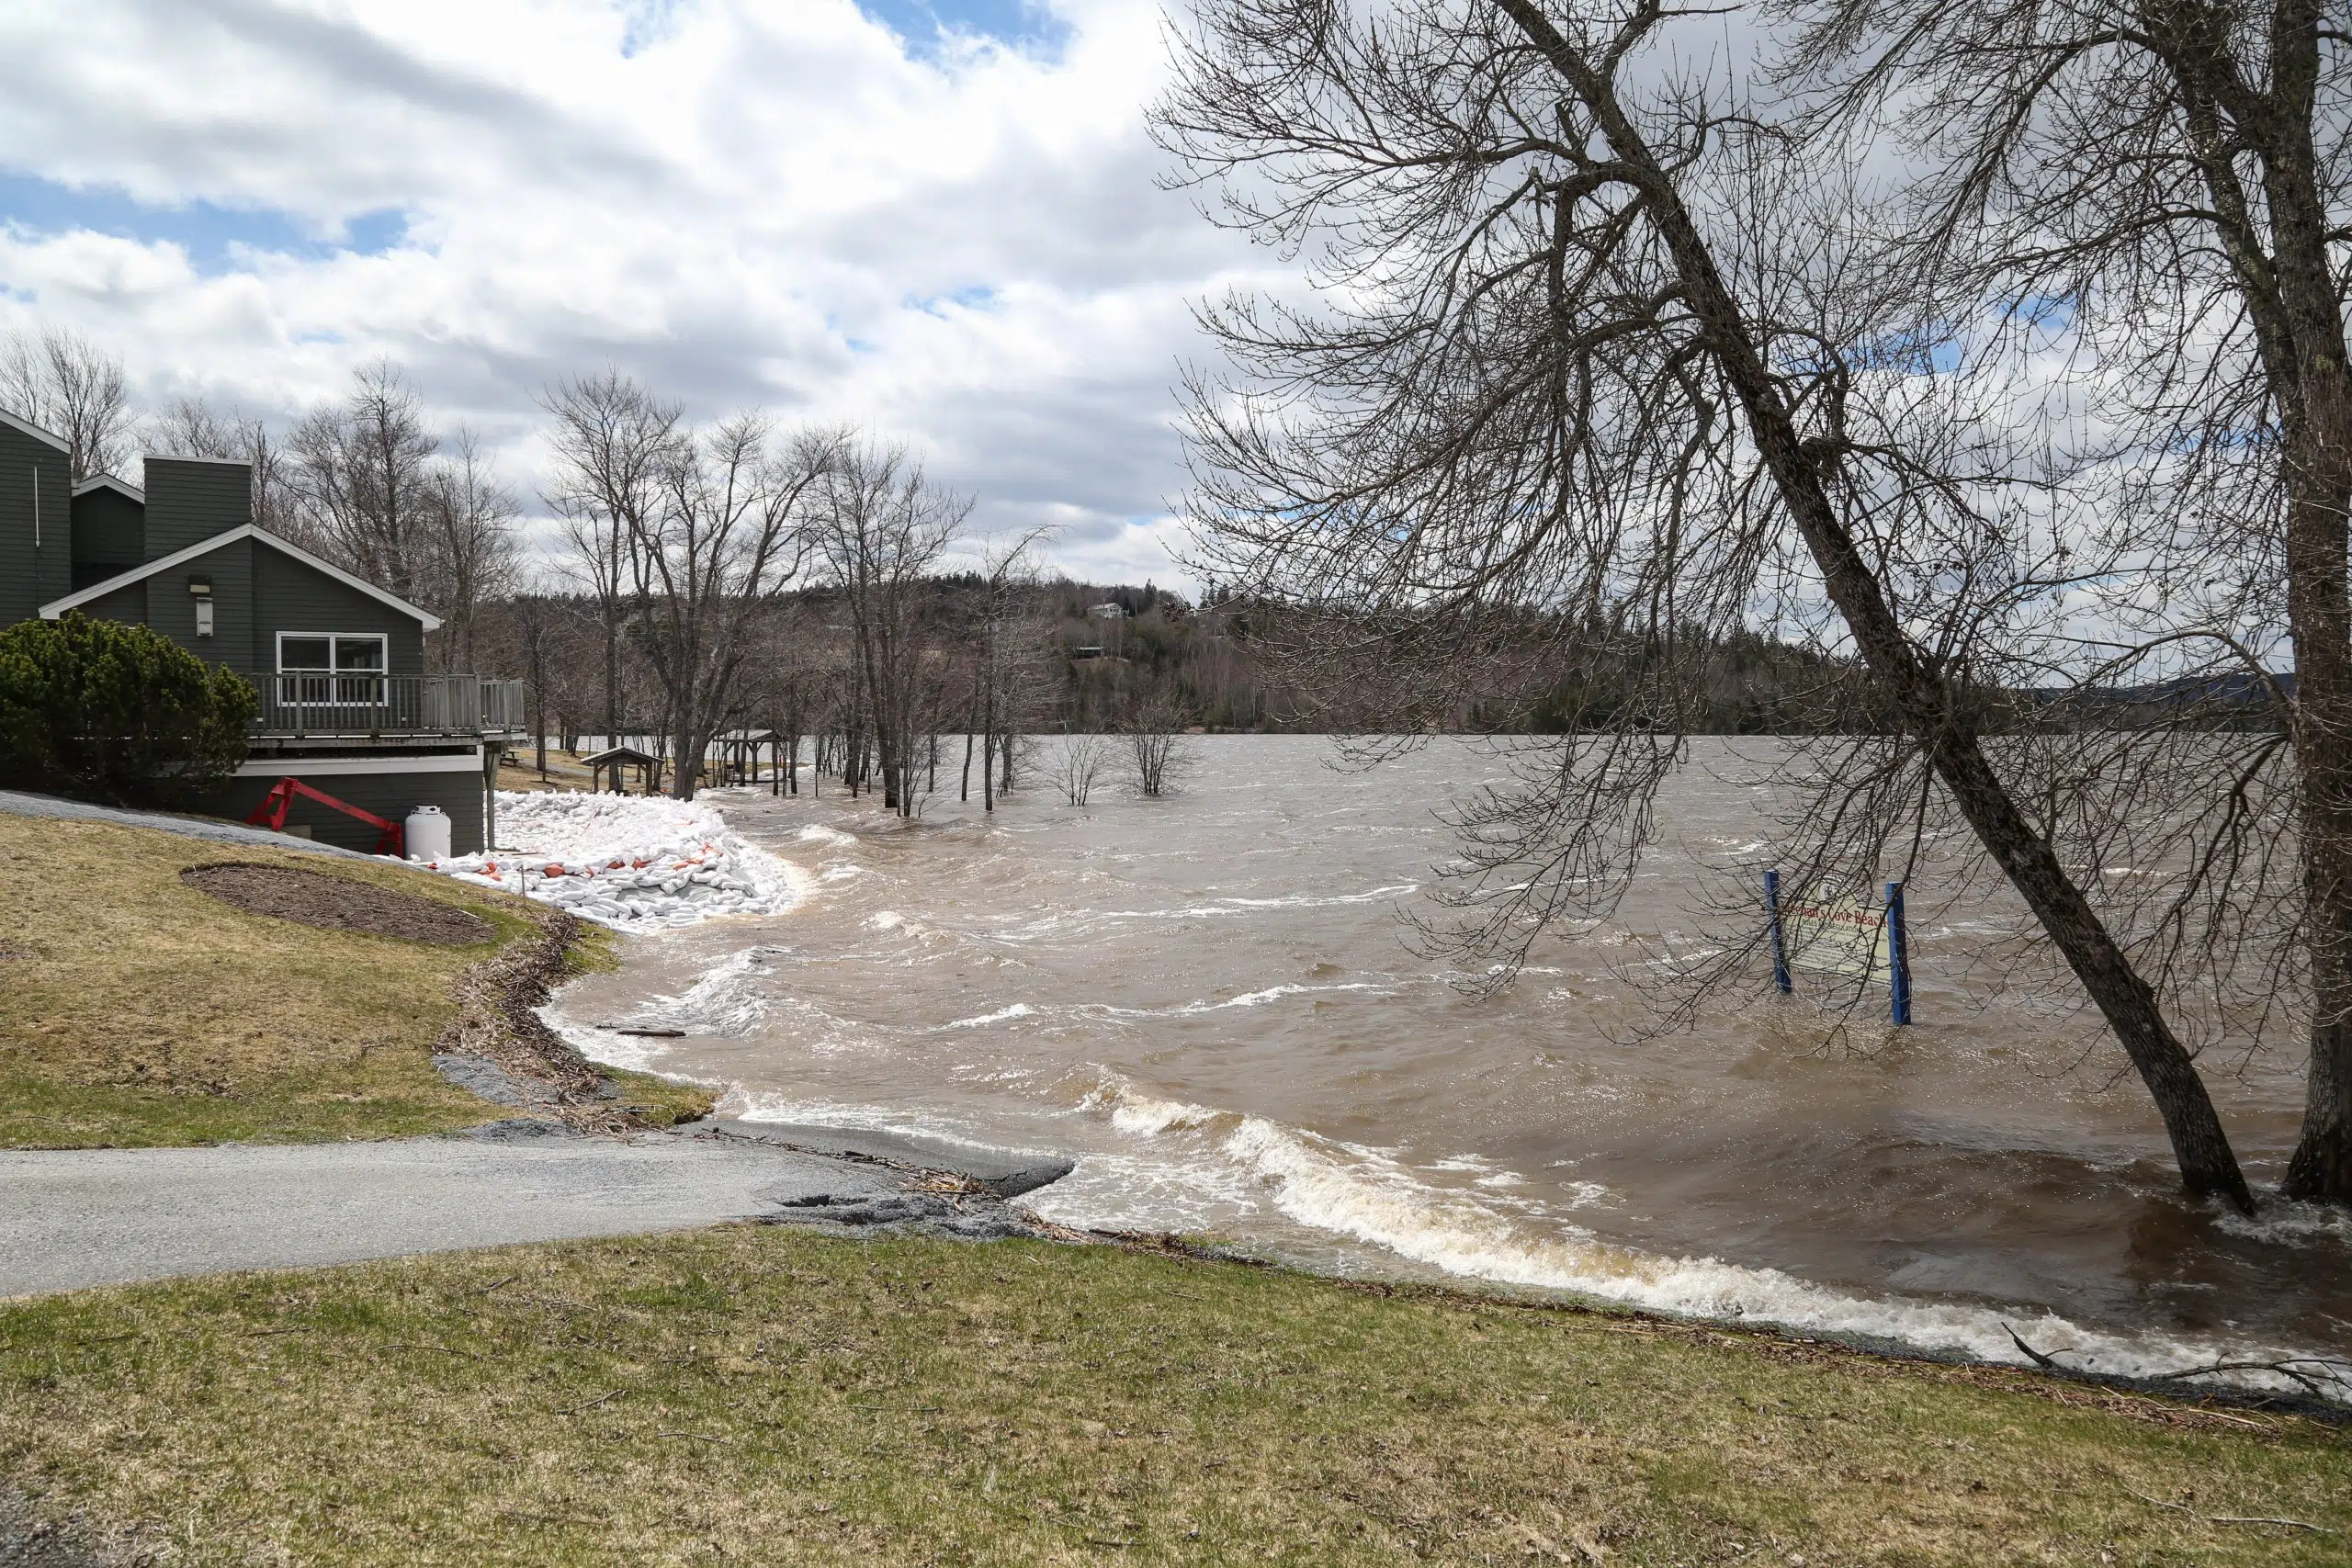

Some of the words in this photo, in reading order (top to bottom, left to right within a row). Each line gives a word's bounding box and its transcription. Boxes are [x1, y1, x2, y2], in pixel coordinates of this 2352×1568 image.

[1802, 919, 1817, 928] RULES
[1829, 922, 1861, 933] REGULATION
[1828, 907, 1852, 922] Cove
[1854, 910, 1887, 928] Beach
